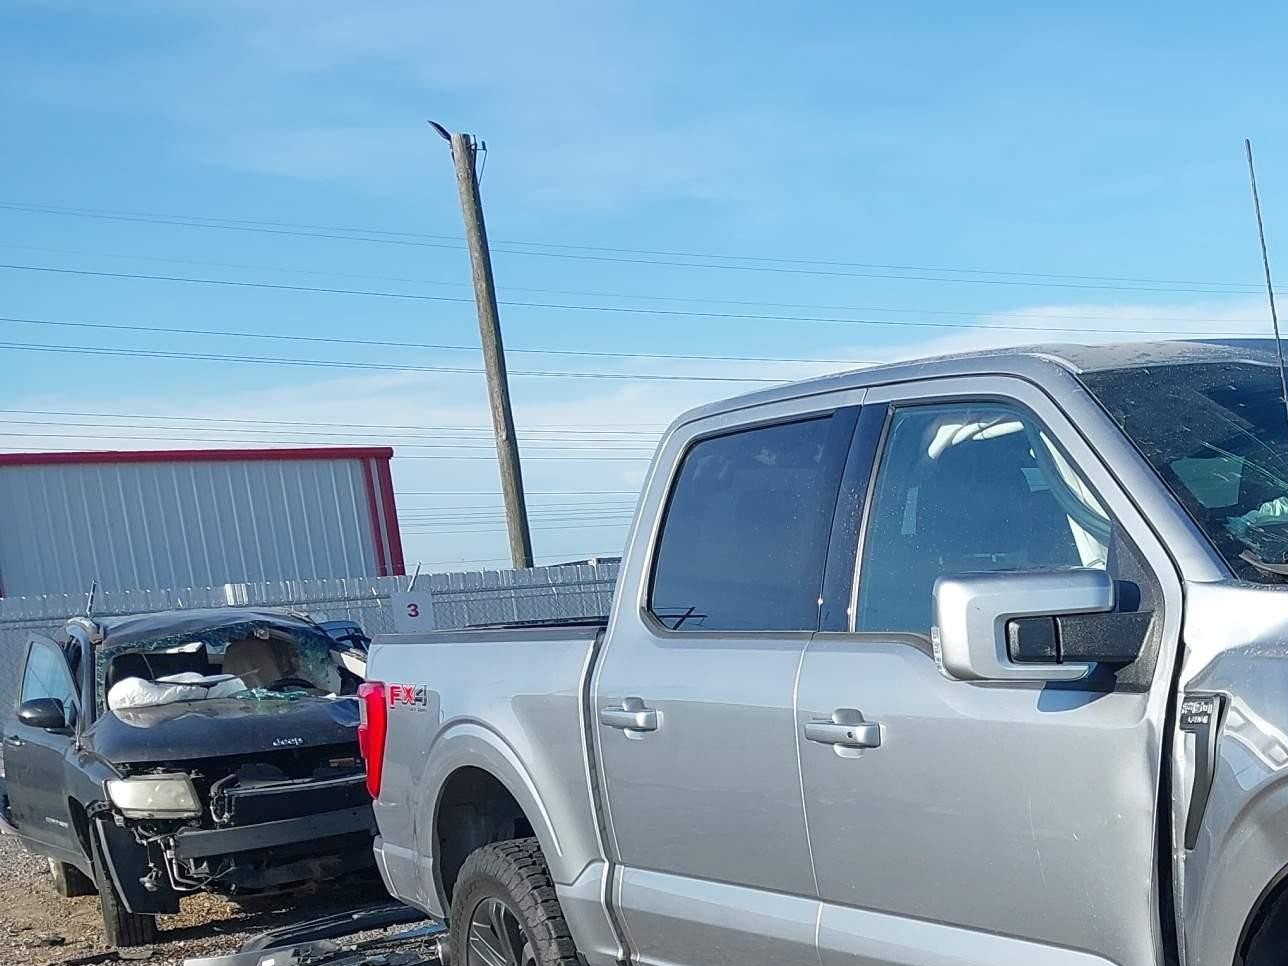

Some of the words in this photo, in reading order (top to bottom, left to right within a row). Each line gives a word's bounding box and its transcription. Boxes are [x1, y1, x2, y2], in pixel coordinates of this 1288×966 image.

[406, 602, 420, 618] 3
[389, 684, 428, 709] FX4
[272, 737, 304, 747] Jeep
